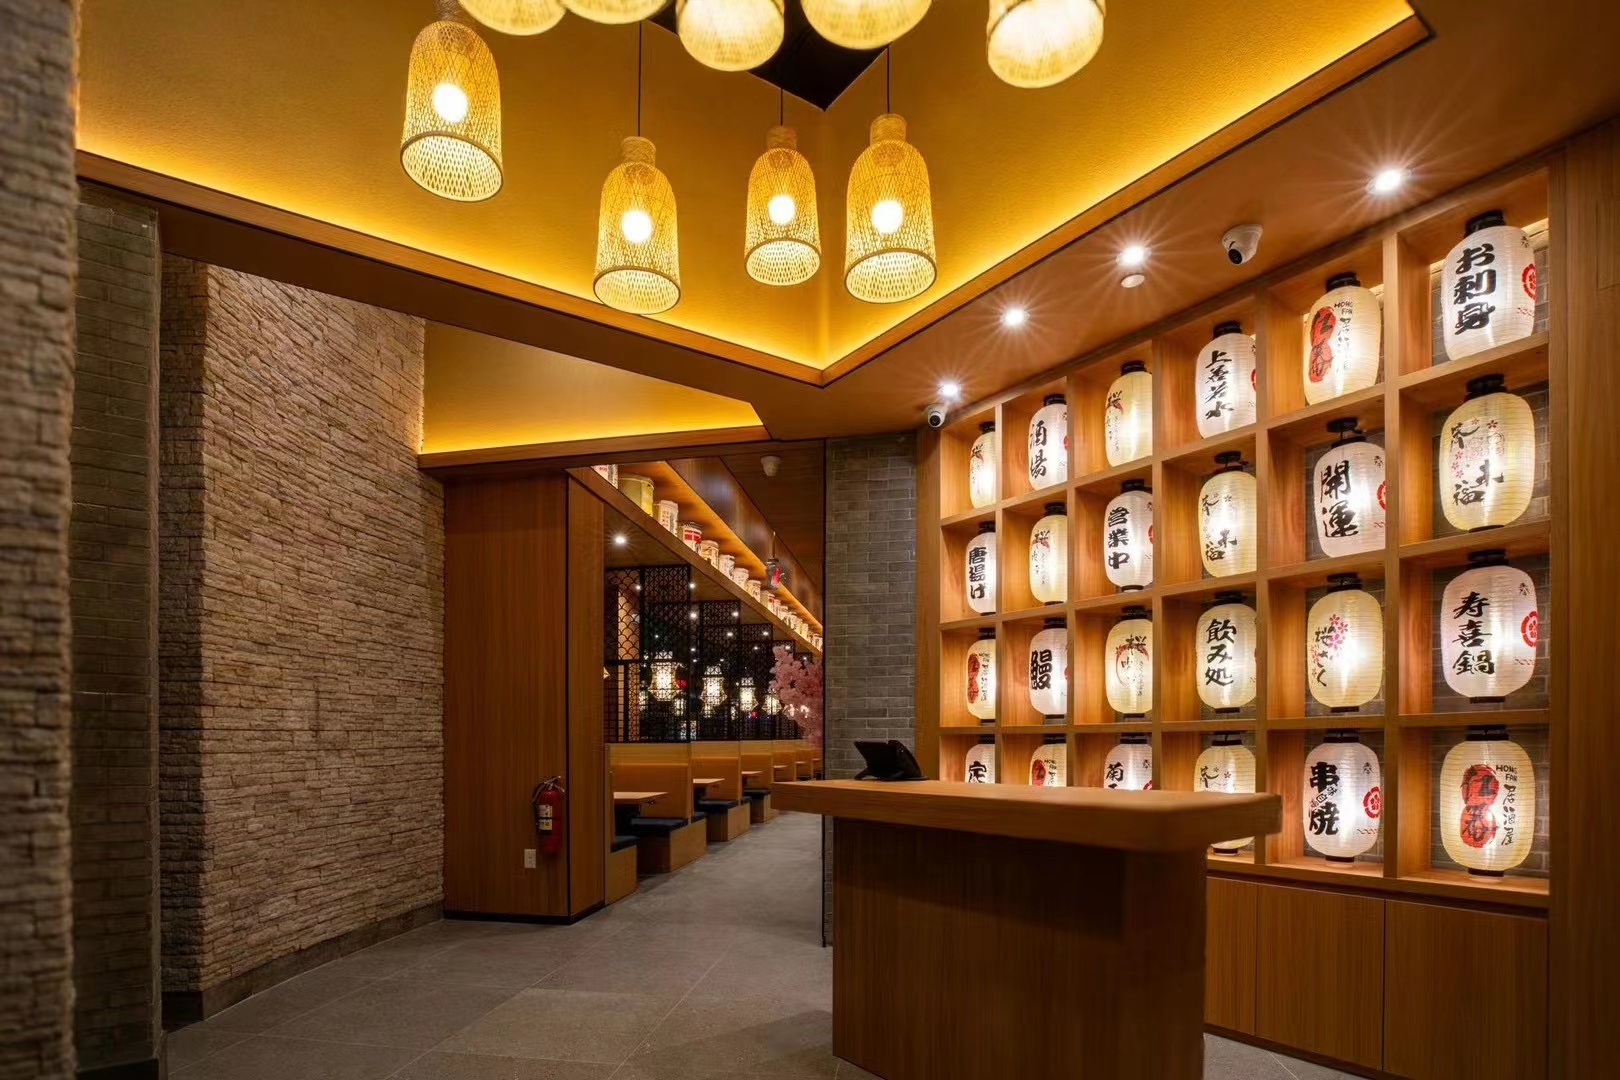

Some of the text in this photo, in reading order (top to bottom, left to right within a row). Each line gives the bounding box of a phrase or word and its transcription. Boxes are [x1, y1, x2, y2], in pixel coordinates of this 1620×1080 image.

[1029, 420, 1047, 479] 酒場
[1320, 460, 1359, 538] 開運
[1206, 619, 1237, 686] 飲み処
[1309, 761, 1340, 835] 串焼
